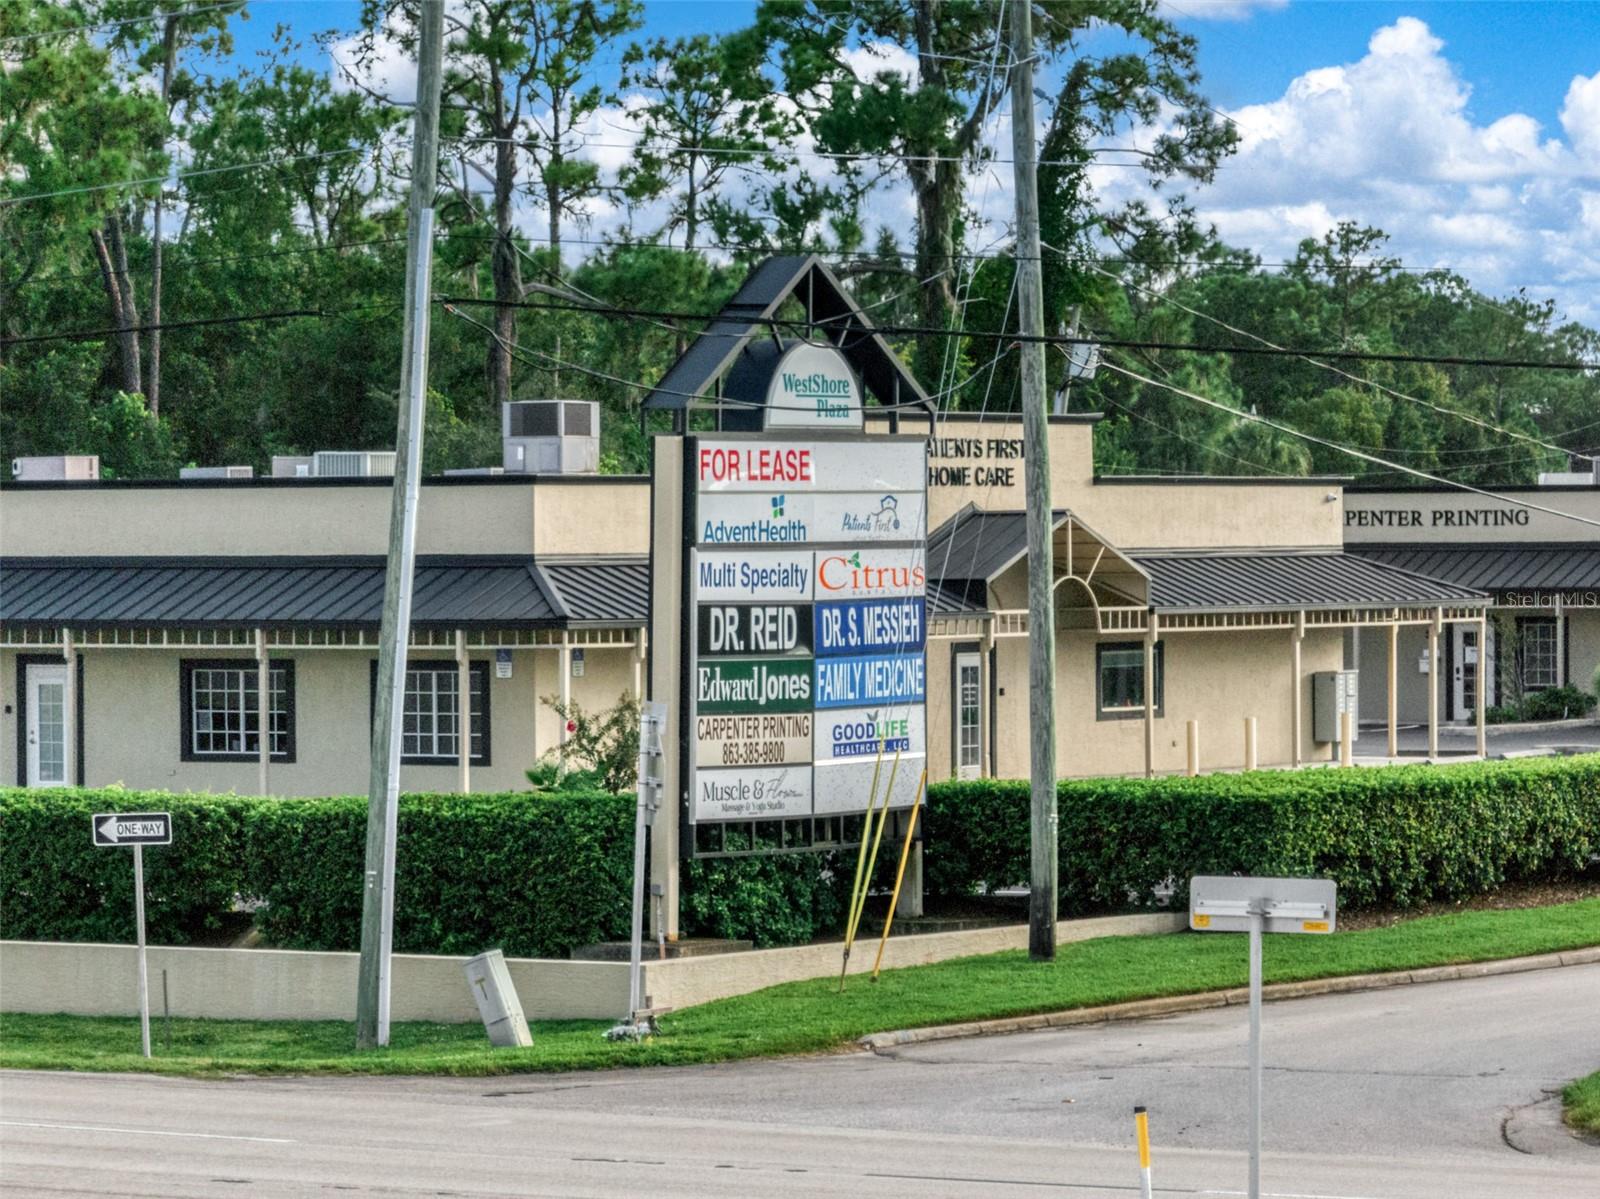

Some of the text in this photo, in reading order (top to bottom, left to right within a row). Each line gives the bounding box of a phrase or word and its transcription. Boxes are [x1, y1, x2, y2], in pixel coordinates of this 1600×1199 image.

[783, 373, 850, 394] WestShore
[817, 399, 850, 418] Plaza
[987, 439, 1025, 458] FIRST
[701, 449, 811, 481] FOR LEASE
[928, 466, 1015, 486] HOME CARE
[1432, 509, 1530, 526] PRINTING
[703, 519, 807, 543] AdventHealth
[700, 562, 808, 594] Multi Specialty
[818, 556, 924, 591] Citrus
[710, 606, 798, 651] DR. REID
[822, 604, 920, 648] DR. S. MESSIEH
[817, 662, 862, 701] FAMILY
[864, 657, 924, 698] MEDICINE
[698, 714, 809, 740] CARPENTER PRINTING
[722, 741, 785, 764] 863-385-9800
[703, 778, 751, 802] Muscle
[753, 779, 764, 800] &
[117, 822, 163, 835] ONE WAY
